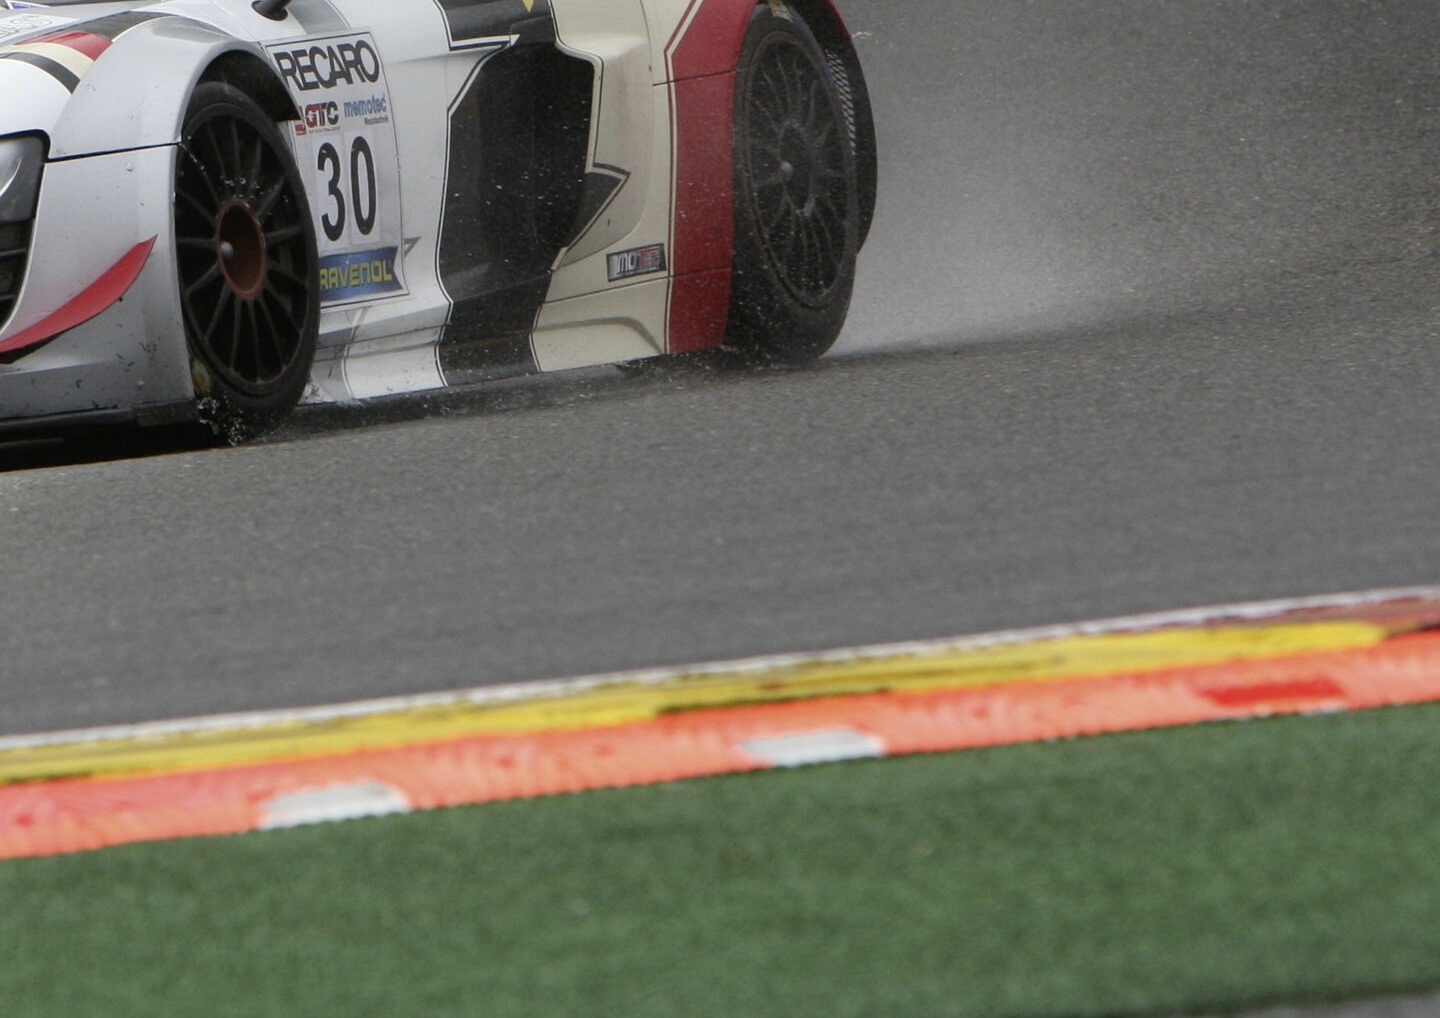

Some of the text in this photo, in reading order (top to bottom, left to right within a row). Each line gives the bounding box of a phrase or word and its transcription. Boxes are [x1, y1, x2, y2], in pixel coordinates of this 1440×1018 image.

[274, 39, 380, 92] RECARO
[343, 93, 388, 119] memotec
[317, 135, 377, 242] 30
[320, 260, 393, 291] RAVENOL
